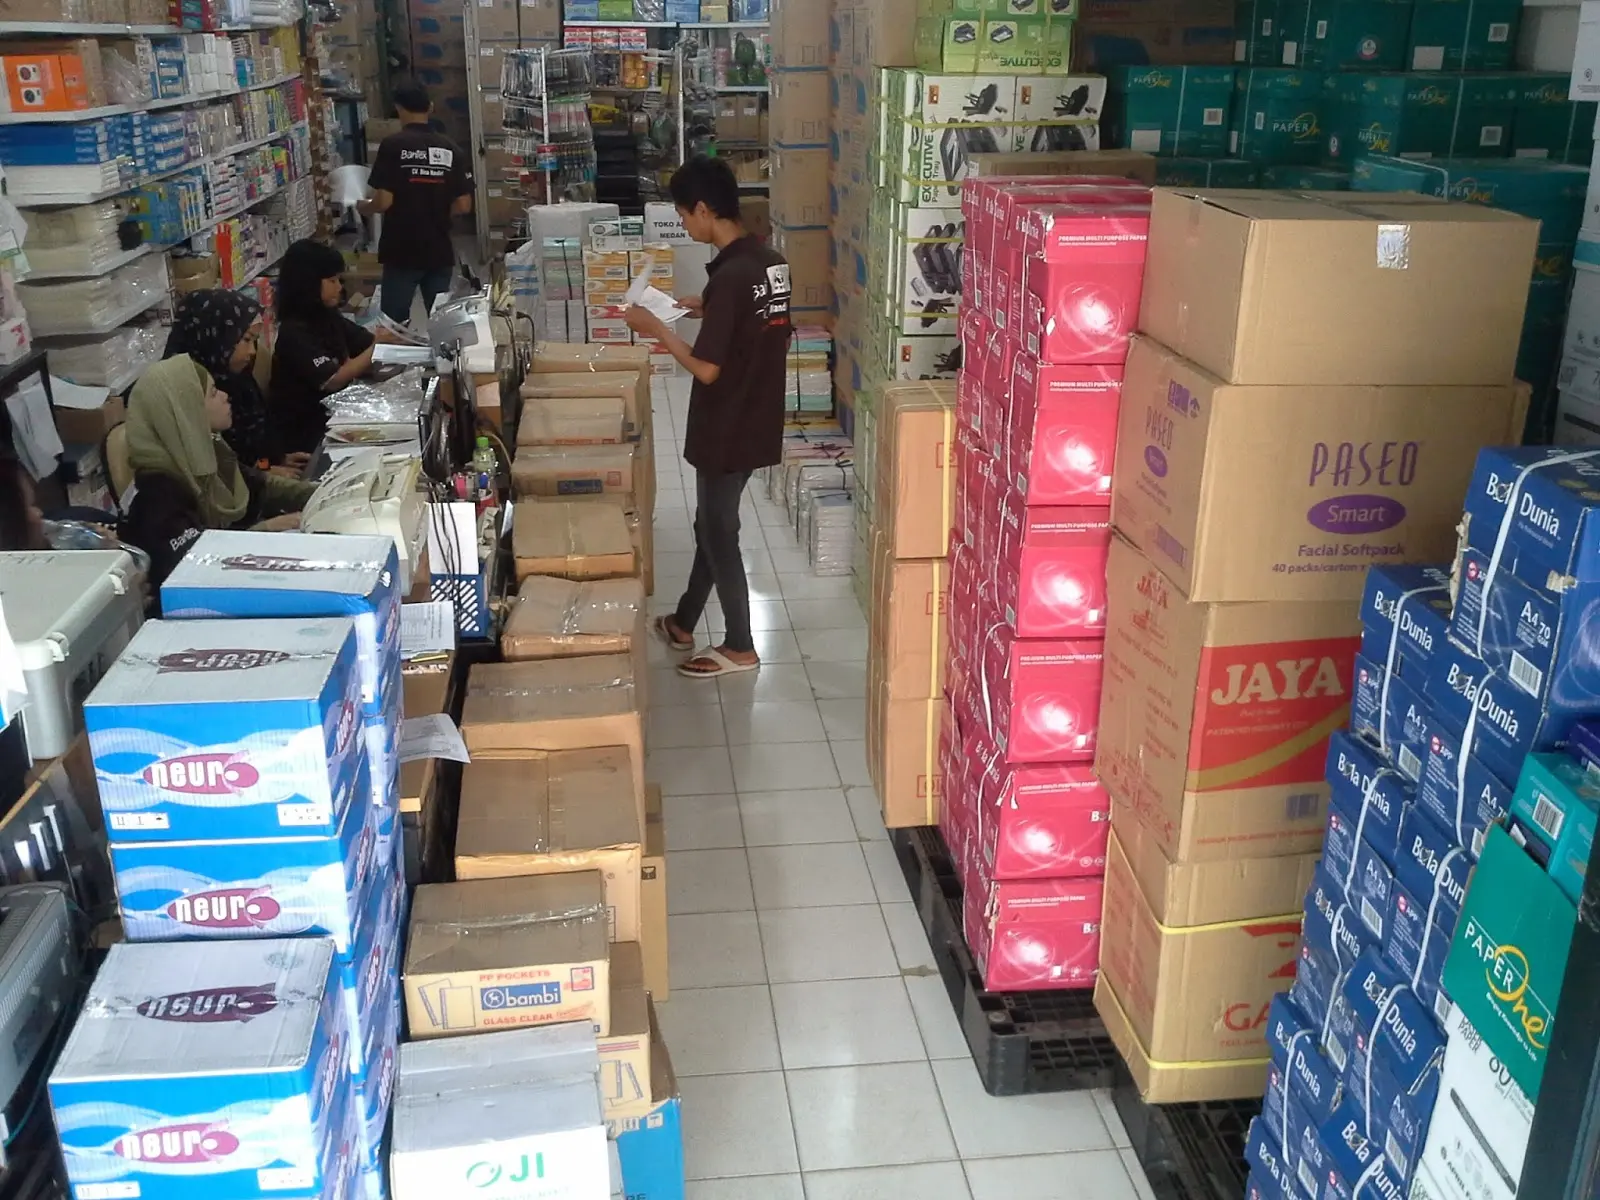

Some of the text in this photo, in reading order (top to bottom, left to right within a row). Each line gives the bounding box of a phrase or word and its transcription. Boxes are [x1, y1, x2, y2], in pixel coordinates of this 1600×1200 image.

[1272, 122, 1309, 133] PAPER
[1309, 441, 1420, 487] PASEO
[1326, 504, 1387, 523] Smart
[1519, 491, 1560, 537] Dunia
[1272, 563, 1287, 573] 40
[1297, 542, 1406, 558] Facial Softpack
[1400, 610, 1434, 652] Dunia
[1520, 600, 1540, 627] A4
[1210, 656, 1345, 706] JAYA
[1478, 688, 1520, 738] Dunia
[1361, 774, 1391, 817] Dunia
[1335, 914, 1361, 958] Dunia
[479, 969, 551, 982] PP POCKETS
[1464, 921, 1515, 994] PAPER
[505, 984, 559, 1007] bambi
[1485, 944, 1546, 1050] One
[483, 1012, 553, 1026] GLASS CLEAR
[1385, 1002, 1418, 1056] Dunia
[1458, 1023, 1482, 1055] PAPER
[1295, 1049, 1322, 1098] Dunia
[1341, 1119, 1370, 1164] Bola
[465, 1151, 545, 1189] OJI
